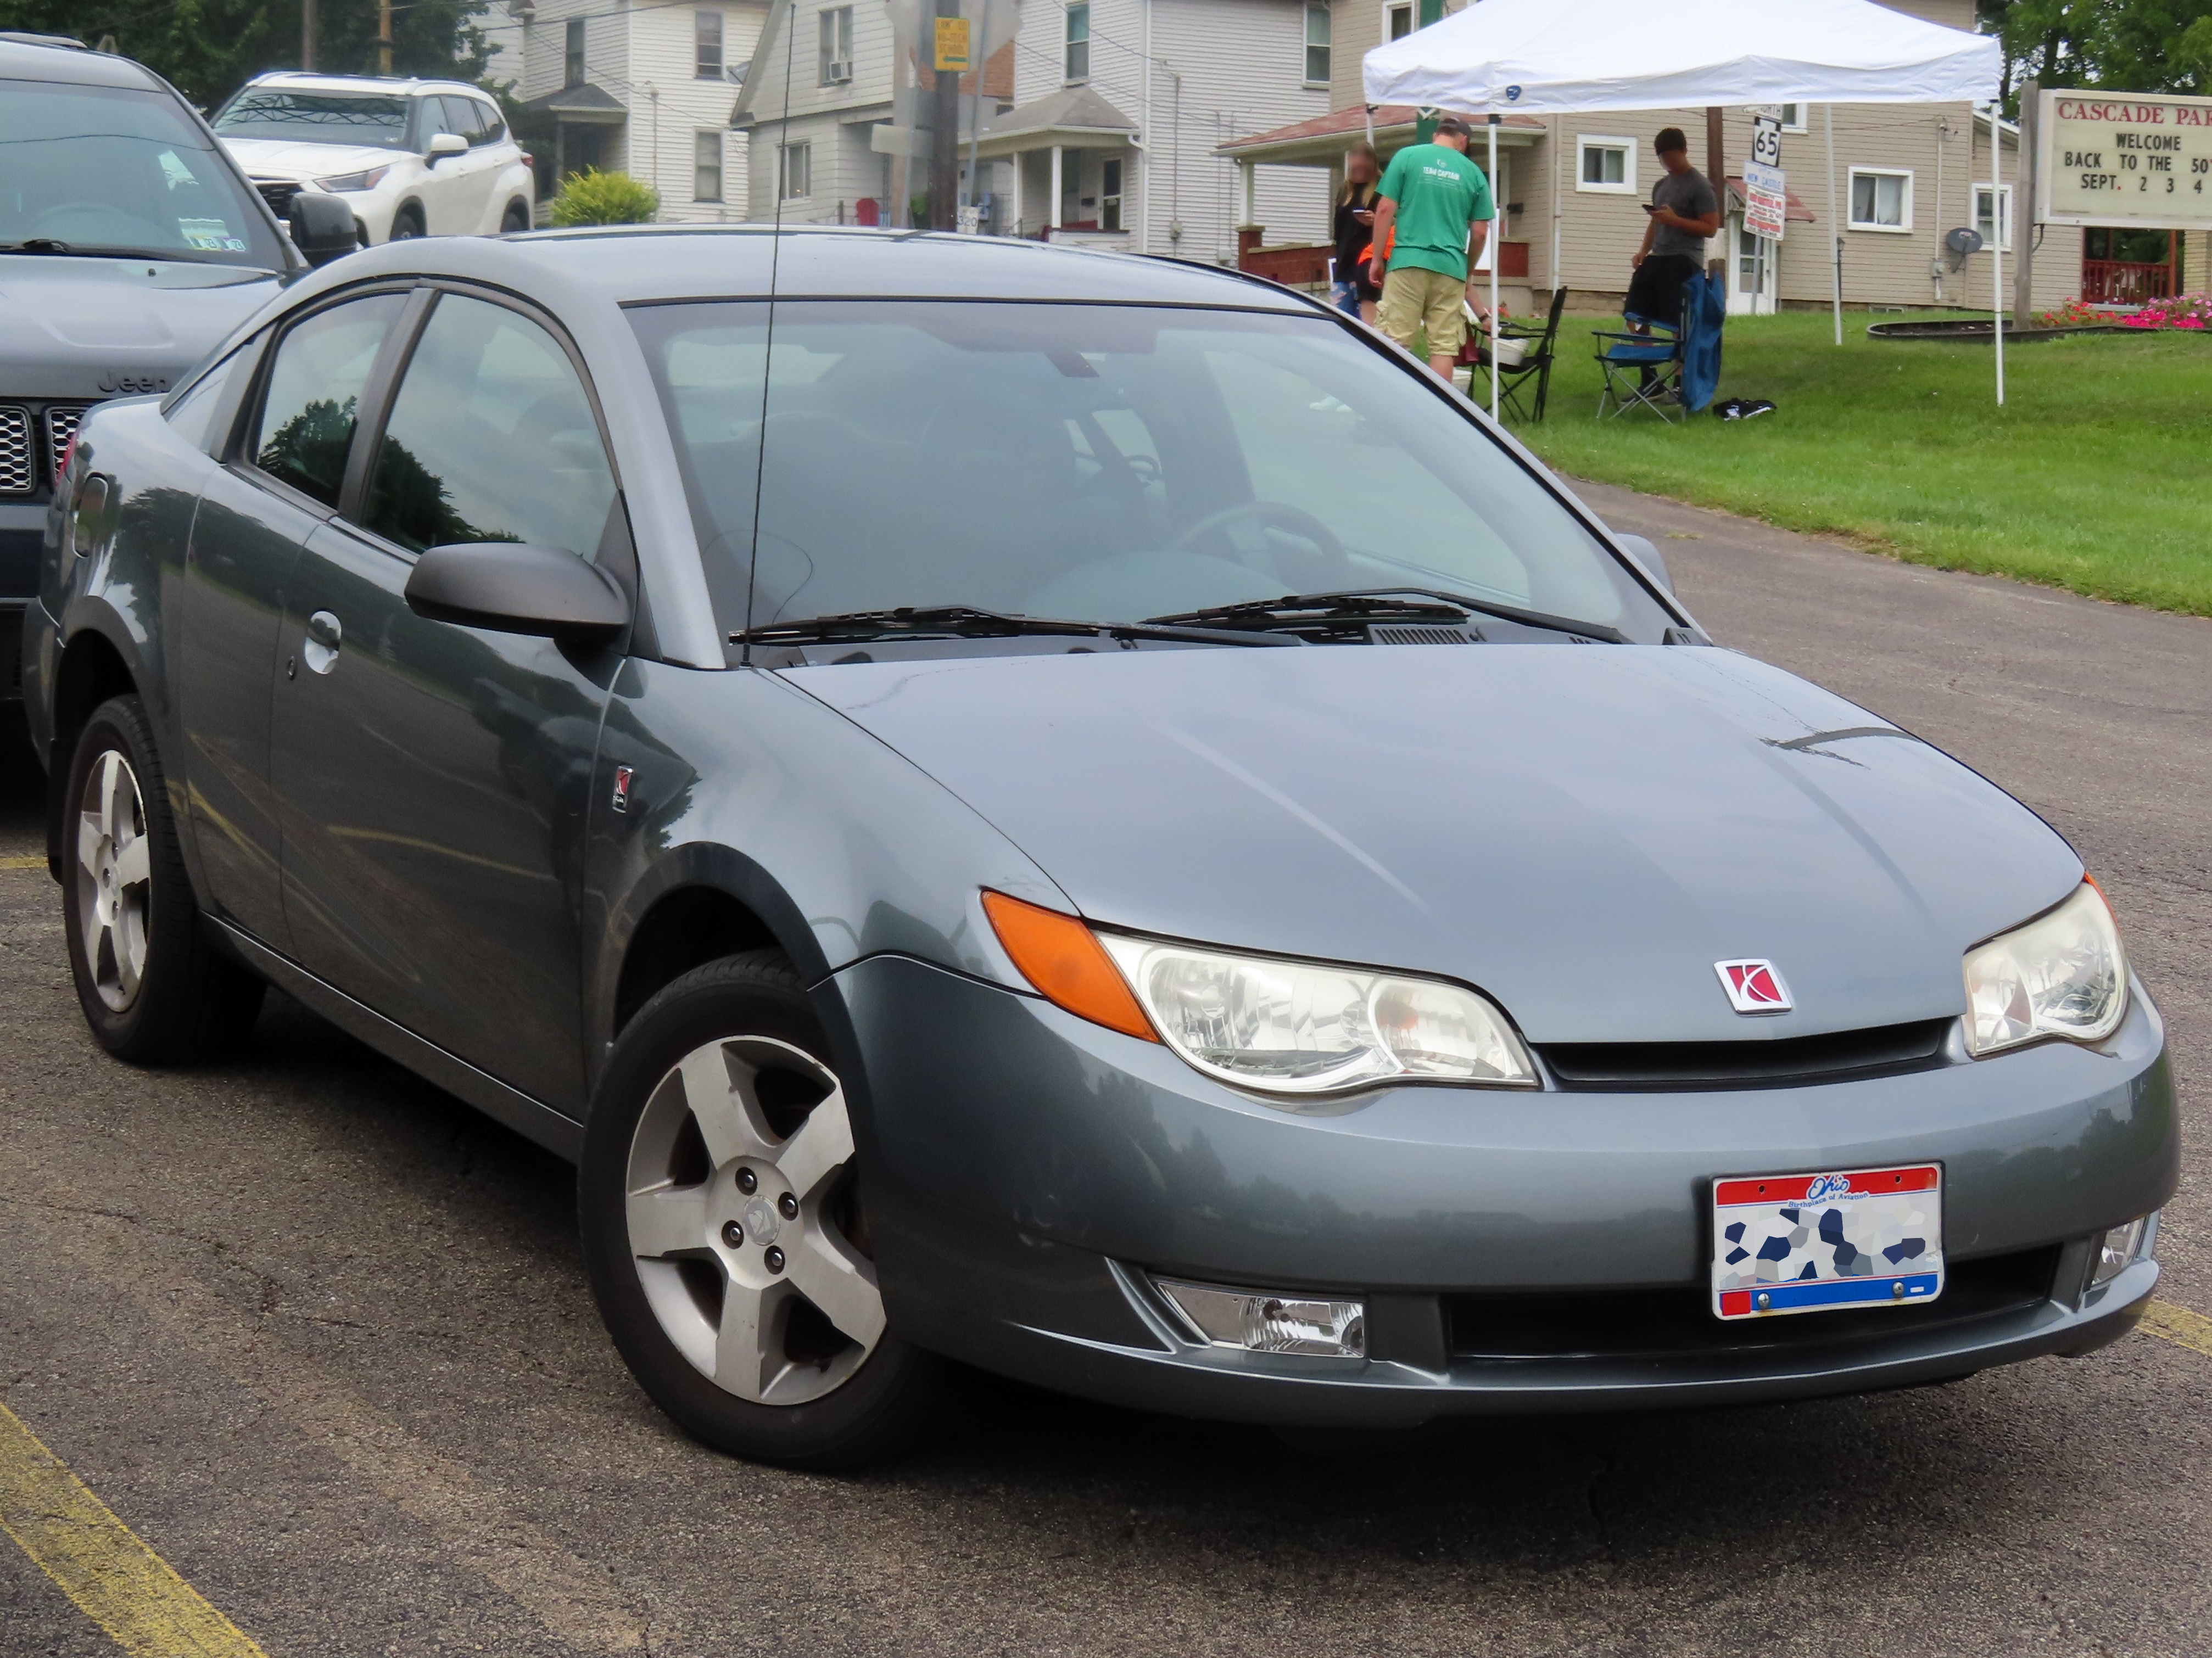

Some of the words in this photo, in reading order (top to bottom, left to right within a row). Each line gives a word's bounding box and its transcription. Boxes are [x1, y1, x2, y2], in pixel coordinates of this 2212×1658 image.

[2058, 102, 2165, 124] CASCADE
[1756, 131, 1778, 156] 65
[2116, 133, 2181, 151] WELCOME
[2065, 151, 2102, 168] BACK
[2120, 154, 2137, 171] TO
[2147, 155, 2171, 171] THE
[2081, 173, 2121, 191] SEPT.
[2140, 176, 2147, 191] 2
[2166, 178, 2174, 193] 3
[2193, 180, 2202, 194] 4
[1808, 1175, 1849, 1200] Ohio
[1788, 1197, 1827, 1208] Birthplace
[1838, 1191, 1869, 1201] Aviation
